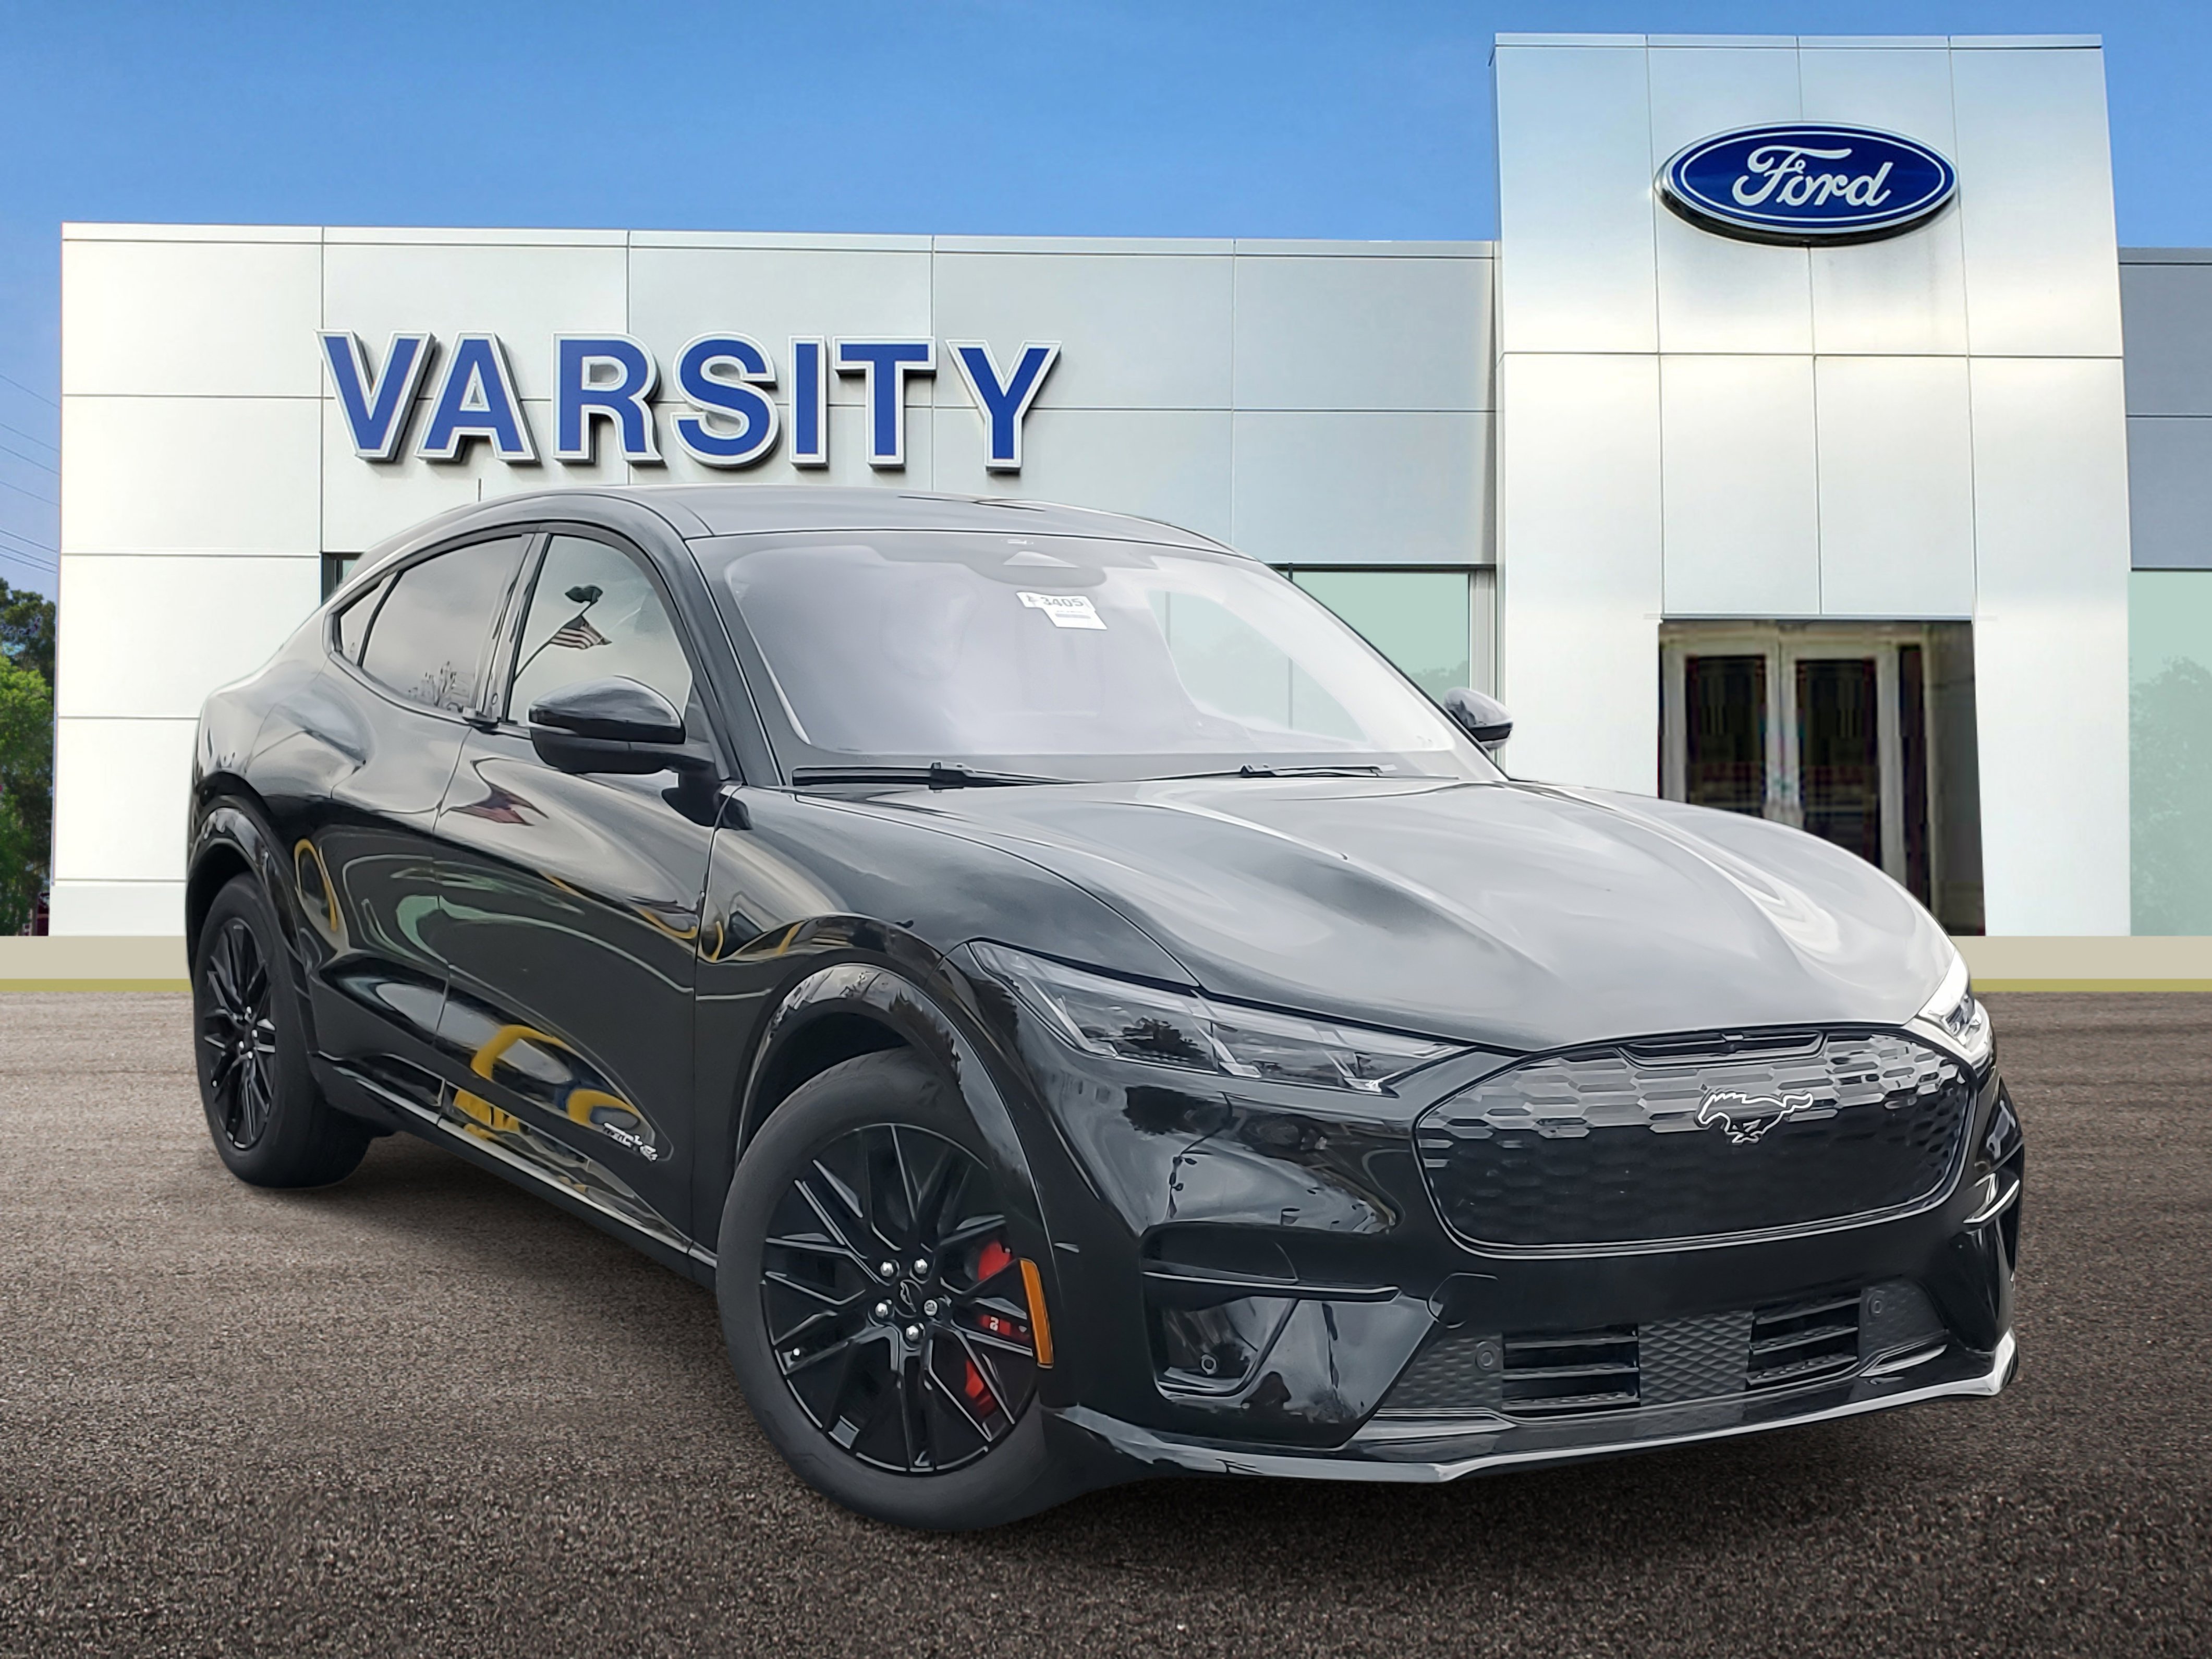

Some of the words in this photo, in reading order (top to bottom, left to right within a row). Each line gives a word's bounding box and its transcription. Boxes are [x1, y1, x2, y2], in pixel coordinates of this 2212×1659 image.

[1732, 145, 1893, 207] Ford
[315, 329, 1061, 470] VARSITY
[1040, 596, 1084, 607] 3405
